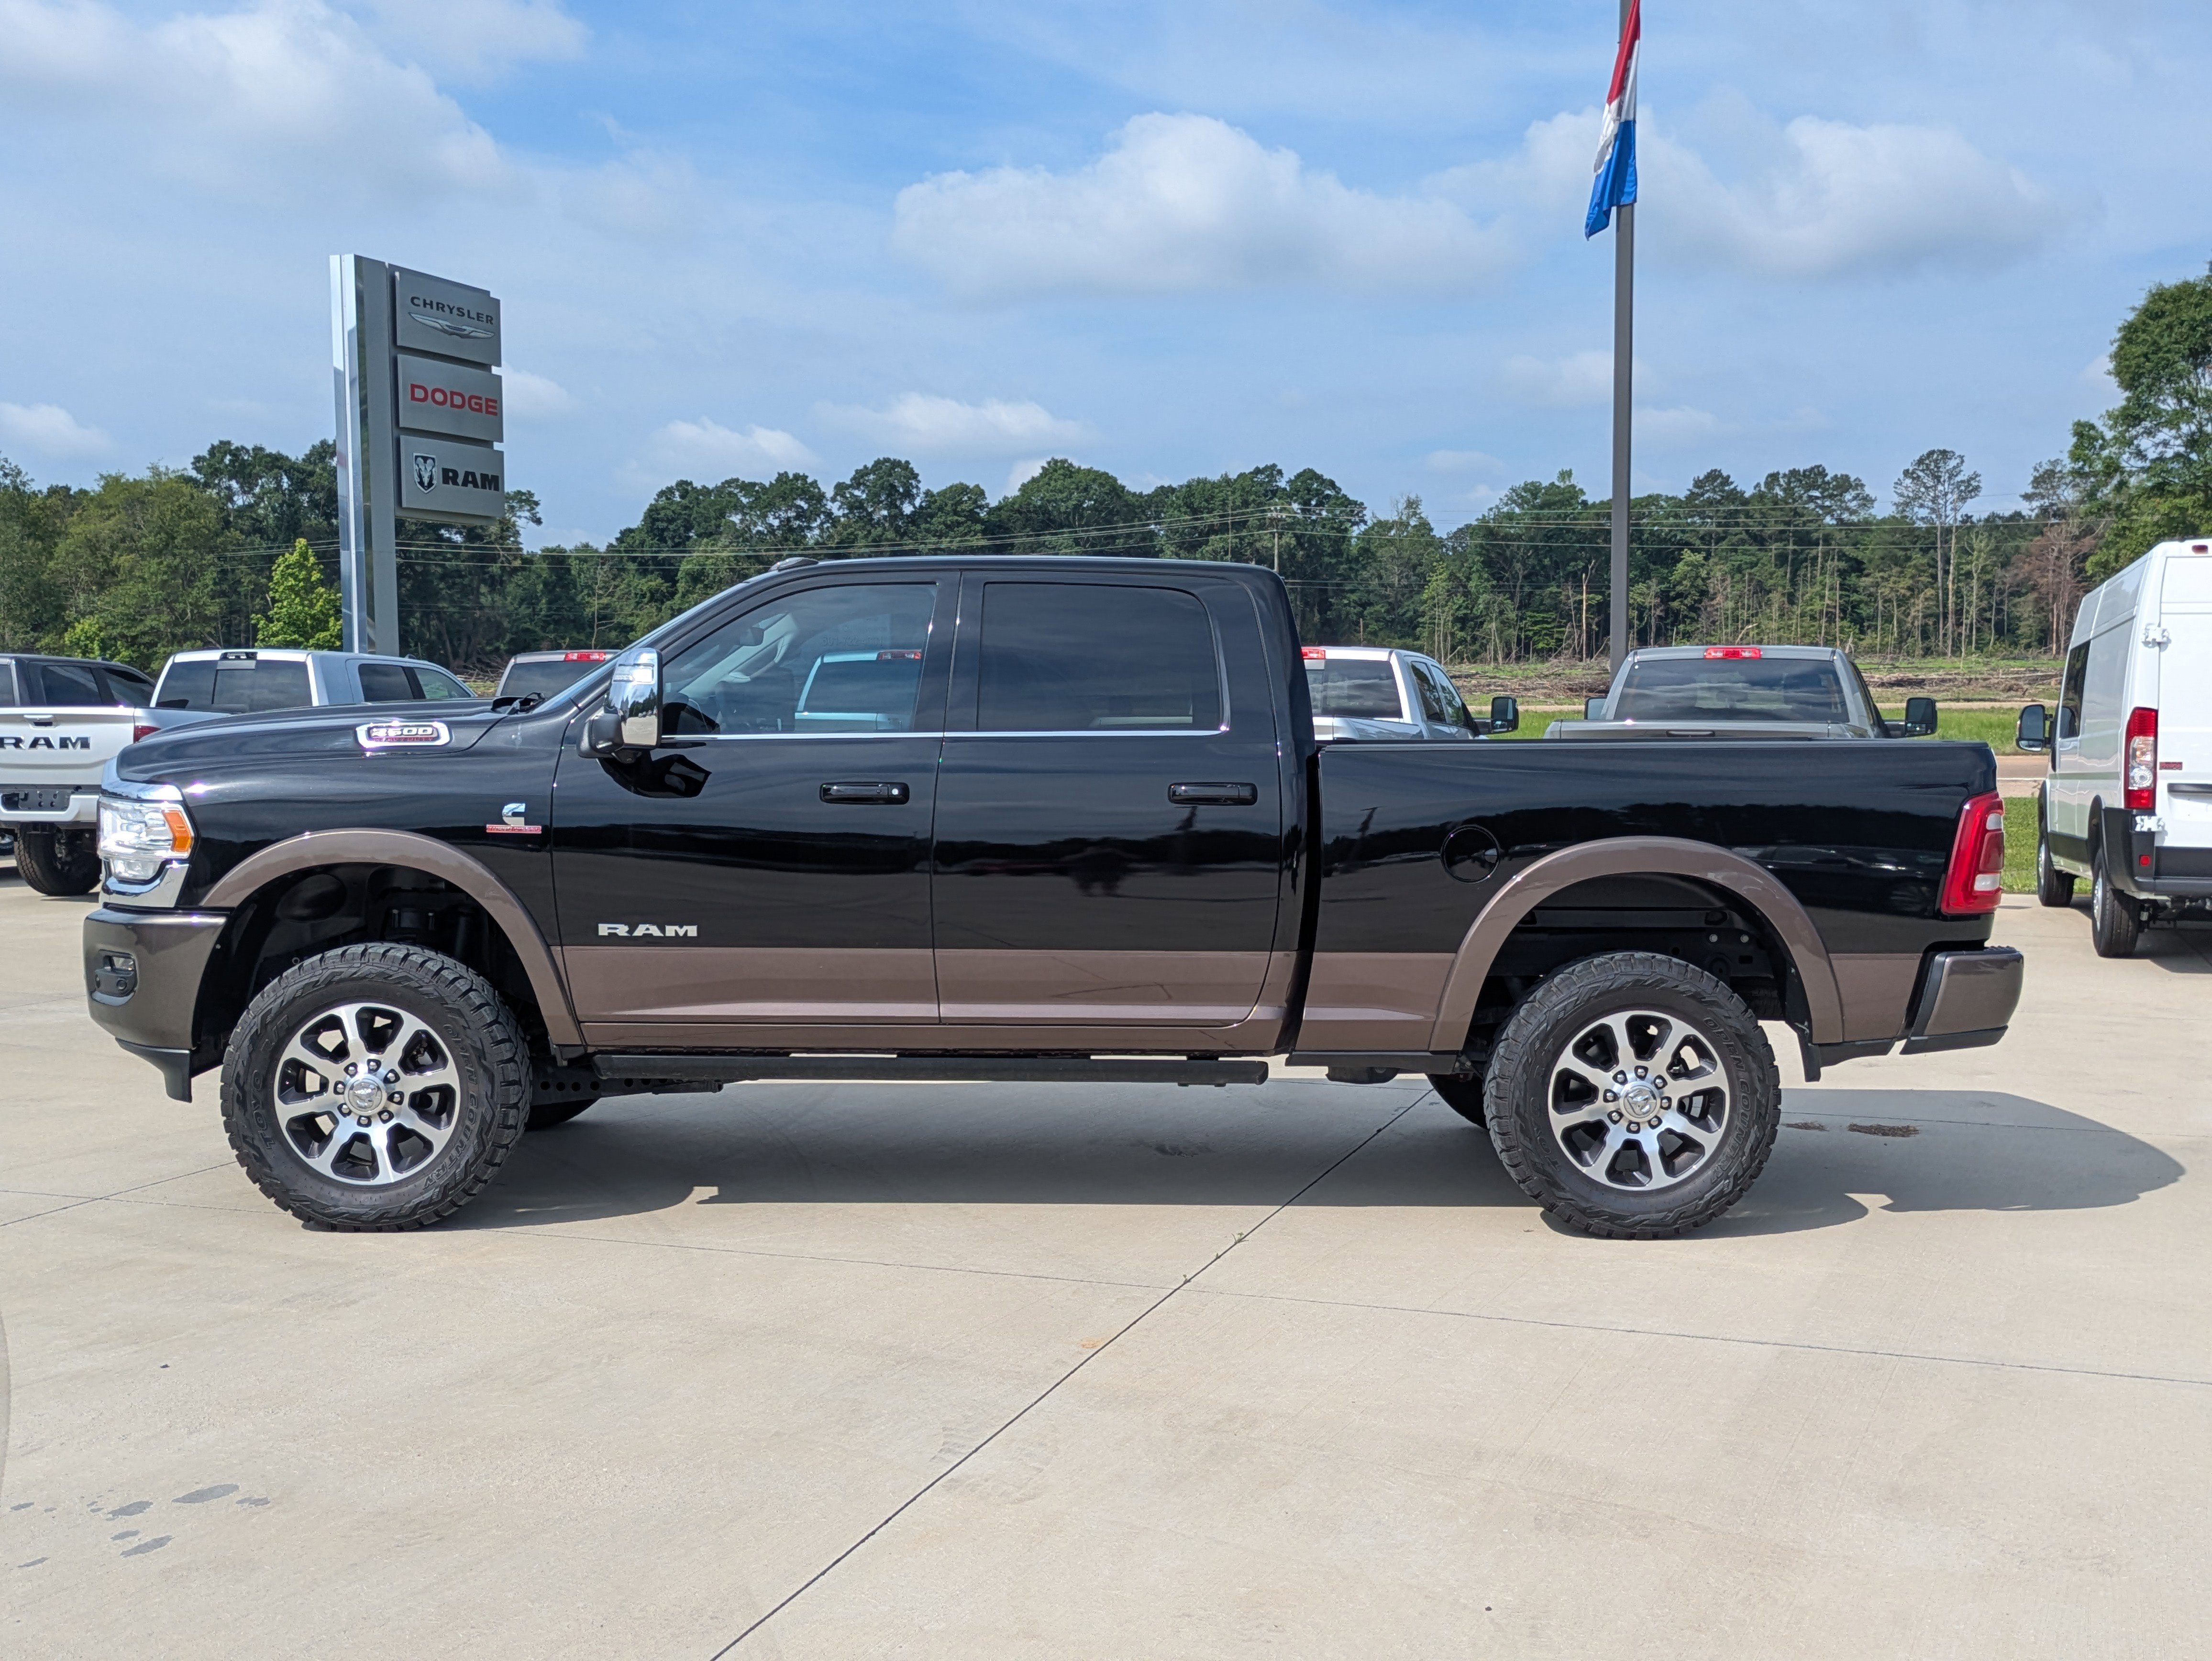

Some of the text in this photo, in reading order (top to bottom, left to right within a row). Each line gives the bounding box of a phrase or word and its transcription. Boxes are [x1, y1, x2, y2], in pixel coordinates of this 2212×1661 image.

[410, 296, 494, 325] CHRYSLER
[410, 383, 498, 416] DODGE
[442, 467, 500, 492] RAM
[0, 736, 90, 750] RAM
[598, 923, 697, 937] RAM
[251, 1070, 276, 1150] TOYO
[1703, 1017, 1751, 1184] OPEN COUNTRY
[422, 1091, 478, 1190] COUNTRY
